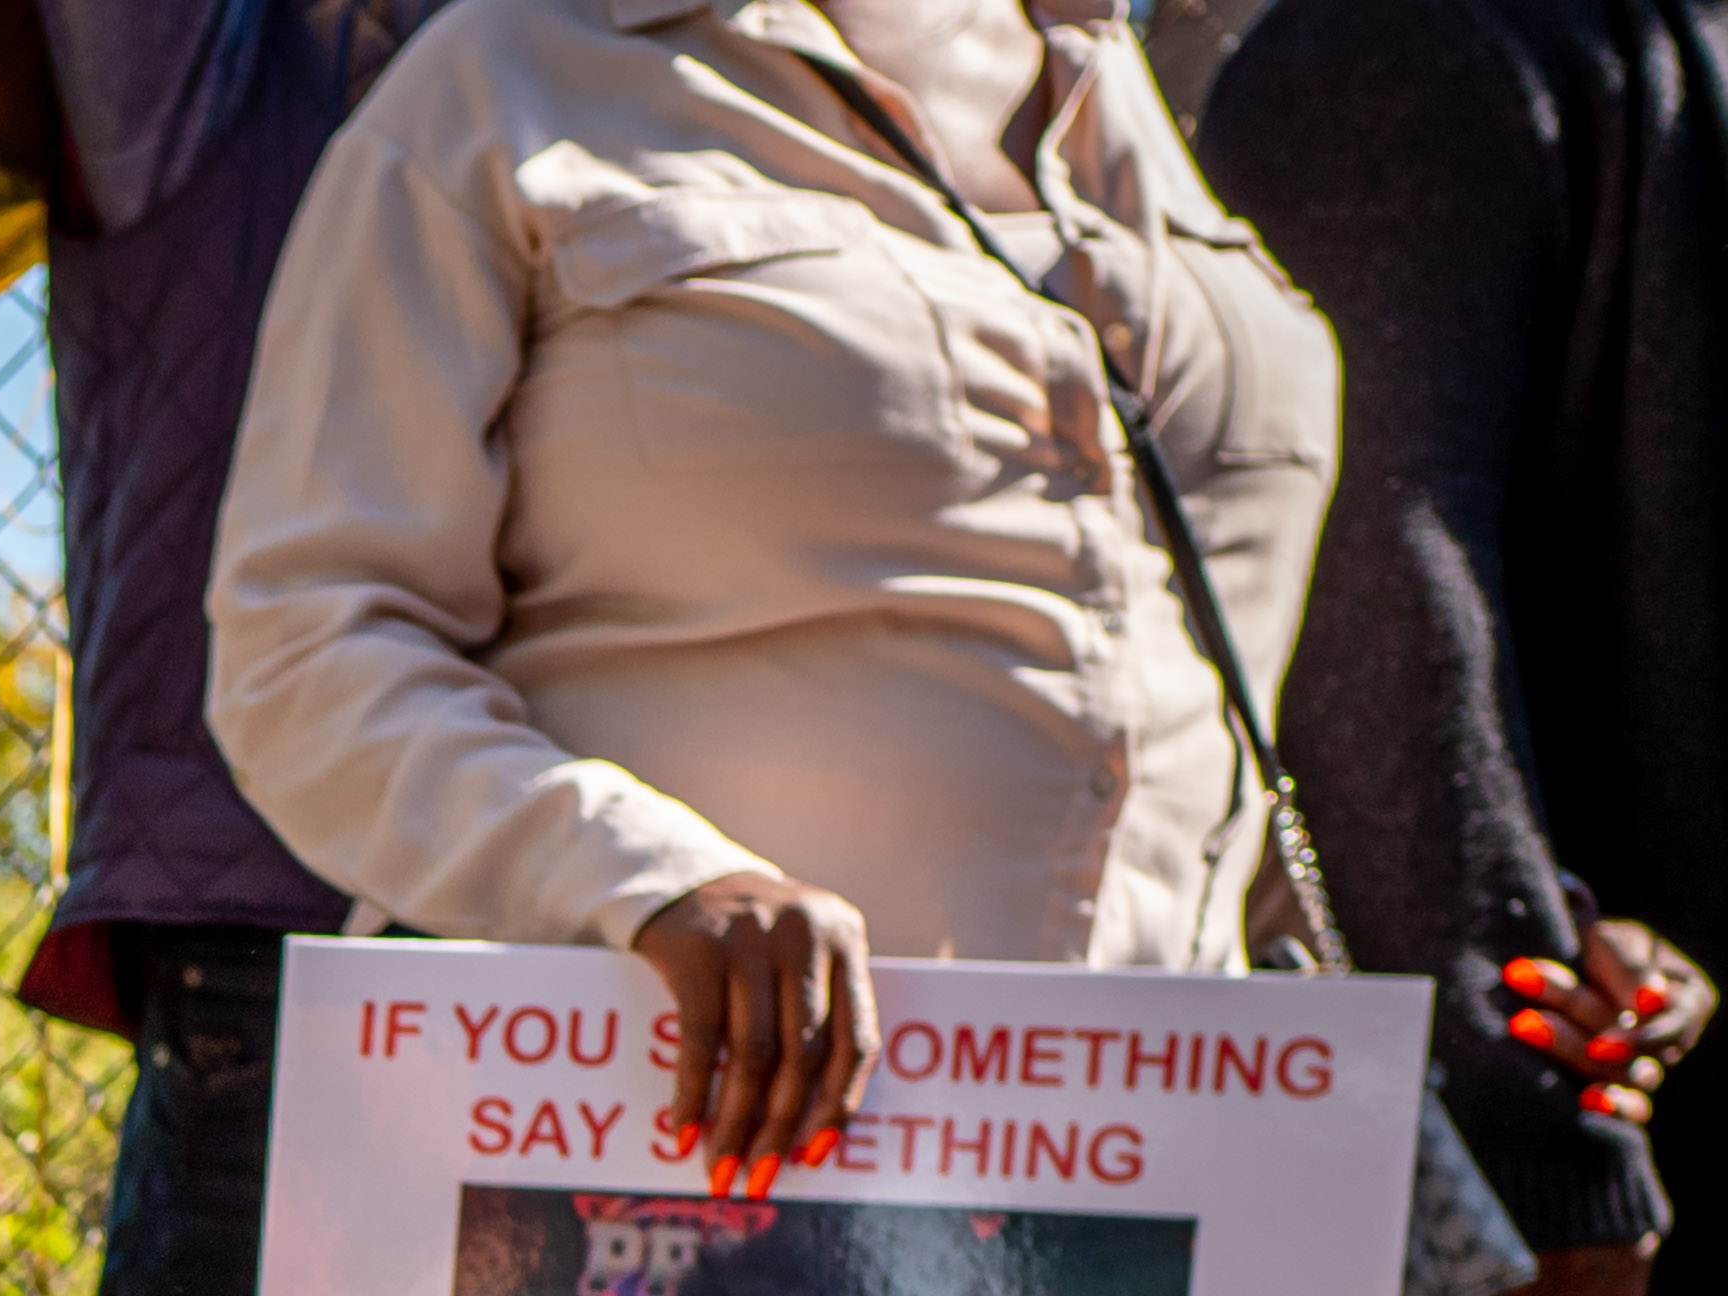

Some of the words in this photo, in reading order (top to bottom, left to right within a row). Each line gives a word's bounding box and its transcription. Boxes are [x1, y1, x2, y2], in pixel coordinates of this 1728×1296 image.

[358, 1001, 428, 1060] IF
[455, 1004, 620, 1068] YOU
[884, 1021, 1333, 1096] OMETHING
[467, 1095, 624, 1160] SAY
[649, 1105, 1144, 1184] SETHING
